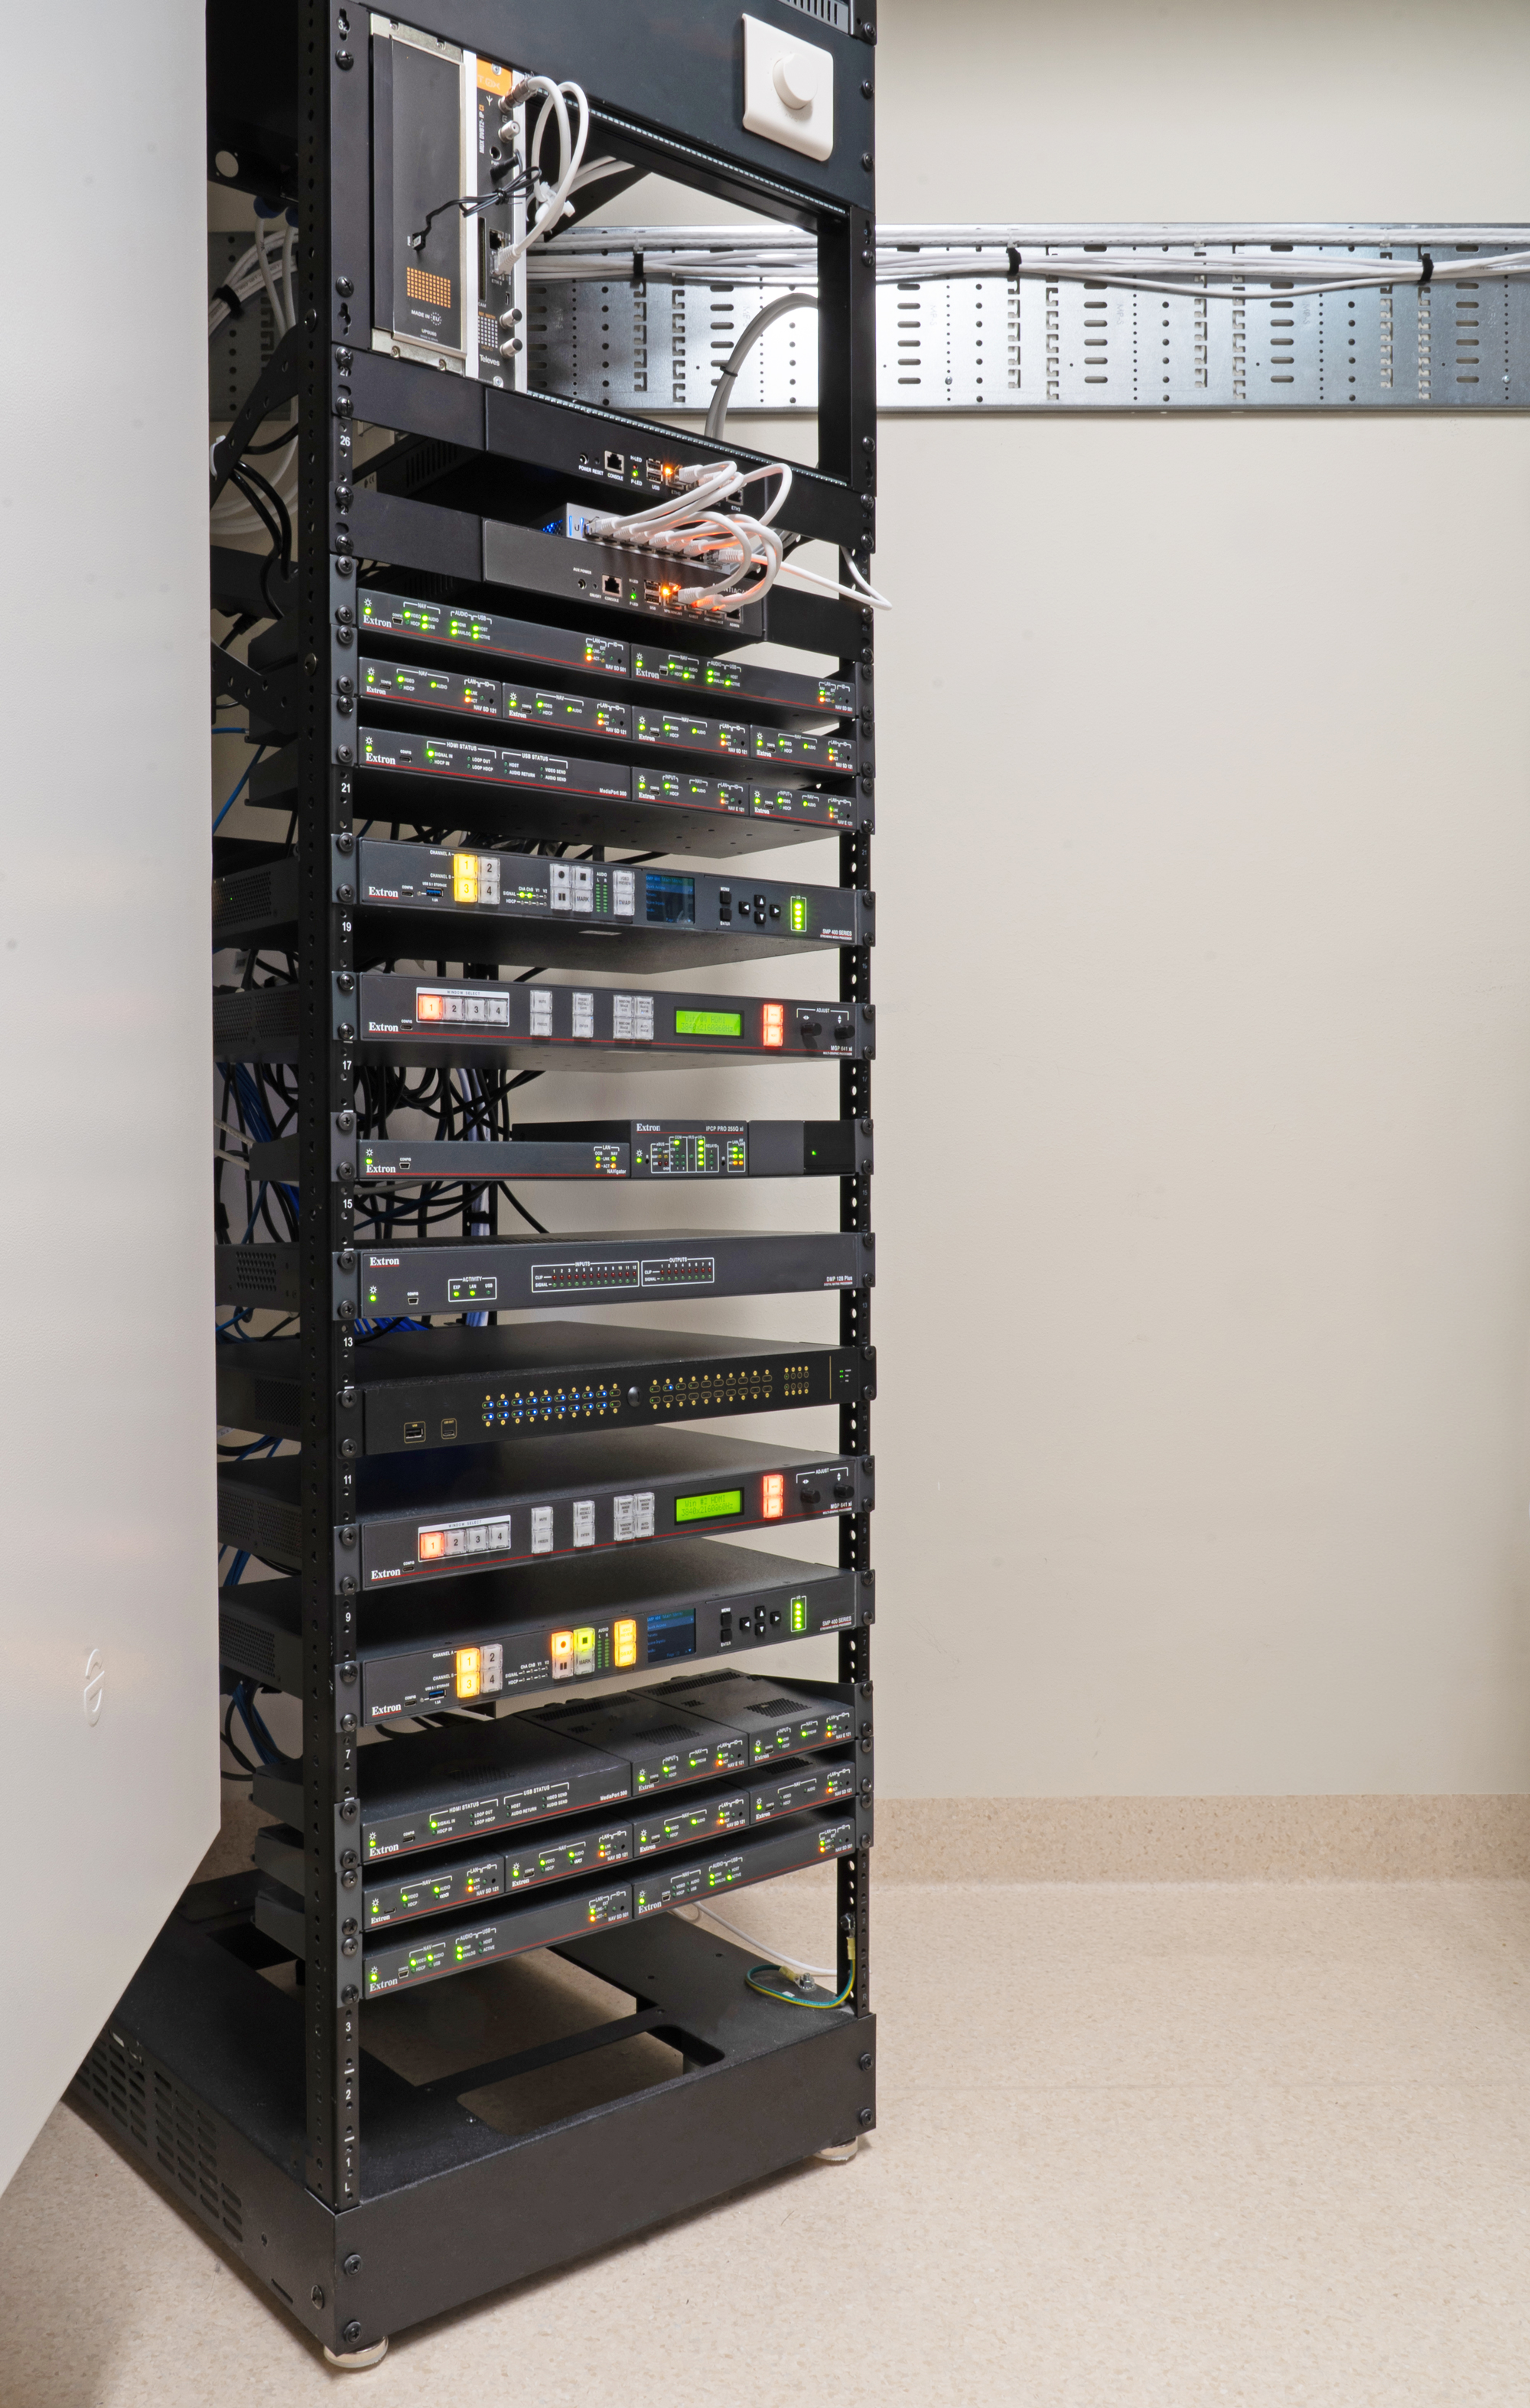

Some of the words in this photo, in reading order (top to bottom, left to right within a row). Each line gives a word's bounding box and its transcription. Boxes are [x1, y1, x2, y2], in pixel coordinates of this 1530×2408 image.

[411, 309, 424, 318] MADE
[480, 354, 500, 367] Televes
[340, 435, 350, 446] 26
[607, 473, 623, 481] CONSOLE
[363, 615, 392, 627] Extron
[636, 668, 659, 679] Extron
[366, 686, 386, 695] Extron
[509, 710, 526, 718] Extron
[639, 733, 656, 741] Extron
[366, 752, 396, 764] Extron
[341, 783, 350, 793] 21
[754, 806, 770, 815] Extron
[465, 861, 468, 870] 1
[487, 863, 492, 872] 2
[369, 886, 399, 898] Extron
[464, 884, 469, 893] 3
[487, 886, 492, 895] 4
[342, 922, 352, 932] 19
[369, 1022, 399, 1032] Extron
[343, 1061, 352, 1070] 17
[636, 1123, 660, 1132] Extron
[366, 1165, 396, 1173] Extron
[343, 1199, 353, 1209] 15
[369, 1257, 399, 1266] Extron
[343, 1338, 353, 1347] 13
[343, 1475, 351, 1484] 11
[711, 1495, 725, 1504] HDMI
[682, 1503, 733, 1517] 3840x2160@60Hz
[371, 1569, 401, 1579] Extron
[345, 1613, 351, 1622] 9
[467, 1657, 471, 1666] 1
[490, 1653, 495, 1662] 2
[467, 1680, 471, 1689] 3
[490, 1675, 494, 1684] 4
[372, 1704, 402, 1716] Extron
[346, 1749, 351, 1758] 7
[534, 1785, 550, 1794] STATUS
[639, 1783, 655, 1791] Extron
[601, 1792, 619, 1801] MediaPort
[462, 1802, 479, 1810] STATUS
[369, 1844, 399, 1857] Extron
[640, 1844, 656, 1852] Extron
[512, 1879, 529, 1887] Extron
[638, 1901, 662, 1914] Extron
[371, 1914, 390, 1924] Extron
[369, 1979, 398, 1992] Extron
[346, 2022, 351, 2032] 3
[346, 2090, 351, 2100] 2
[347, 2158, 350, 2167] 1
[344, 2183, 350, 2192] L
